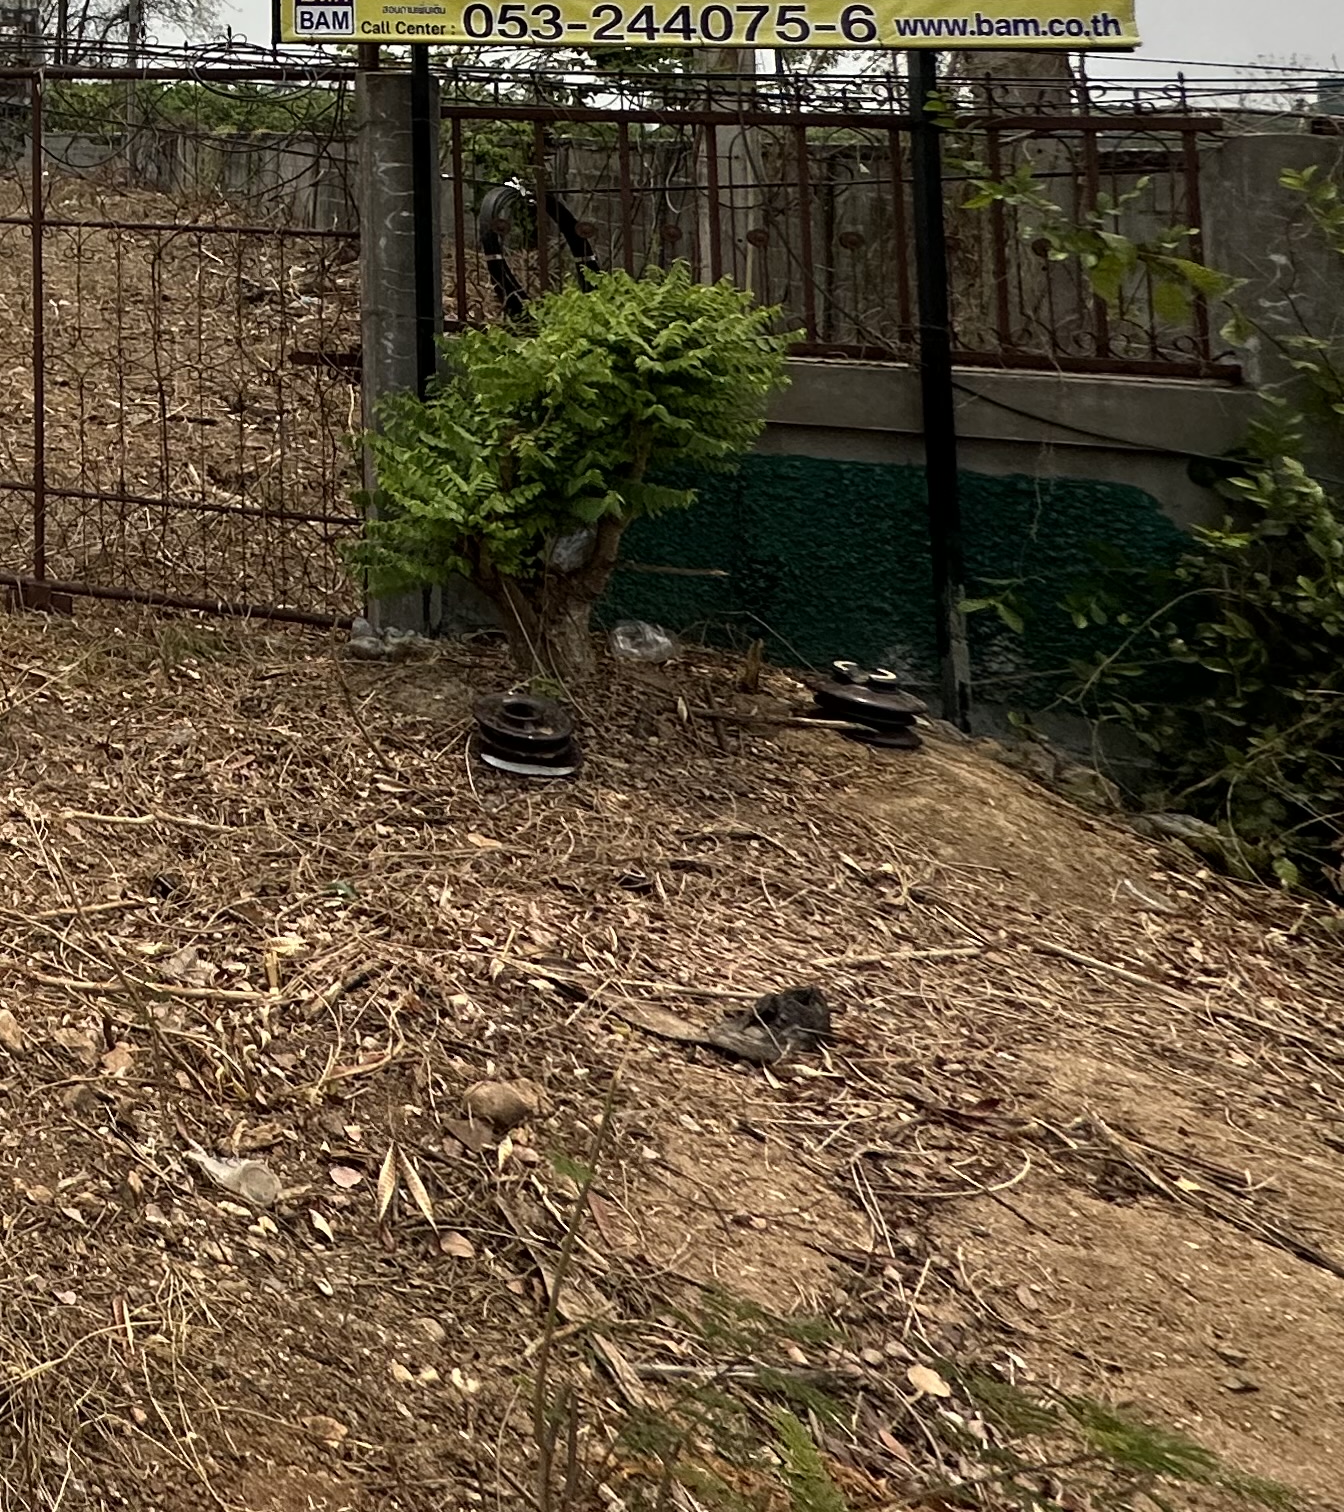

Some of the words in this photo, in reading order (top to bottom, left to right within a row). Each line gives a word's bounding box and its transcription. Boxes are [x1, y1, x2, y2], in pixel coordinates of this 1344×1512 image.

[299, 11, 349, 30] BAM
[362, 20, 391, 35] Call
[395, 20, 446, 35] Center
[463, 3, 877, 43] 053-244075-6
[894, 12, 1122, 37] www.bam.co.th
